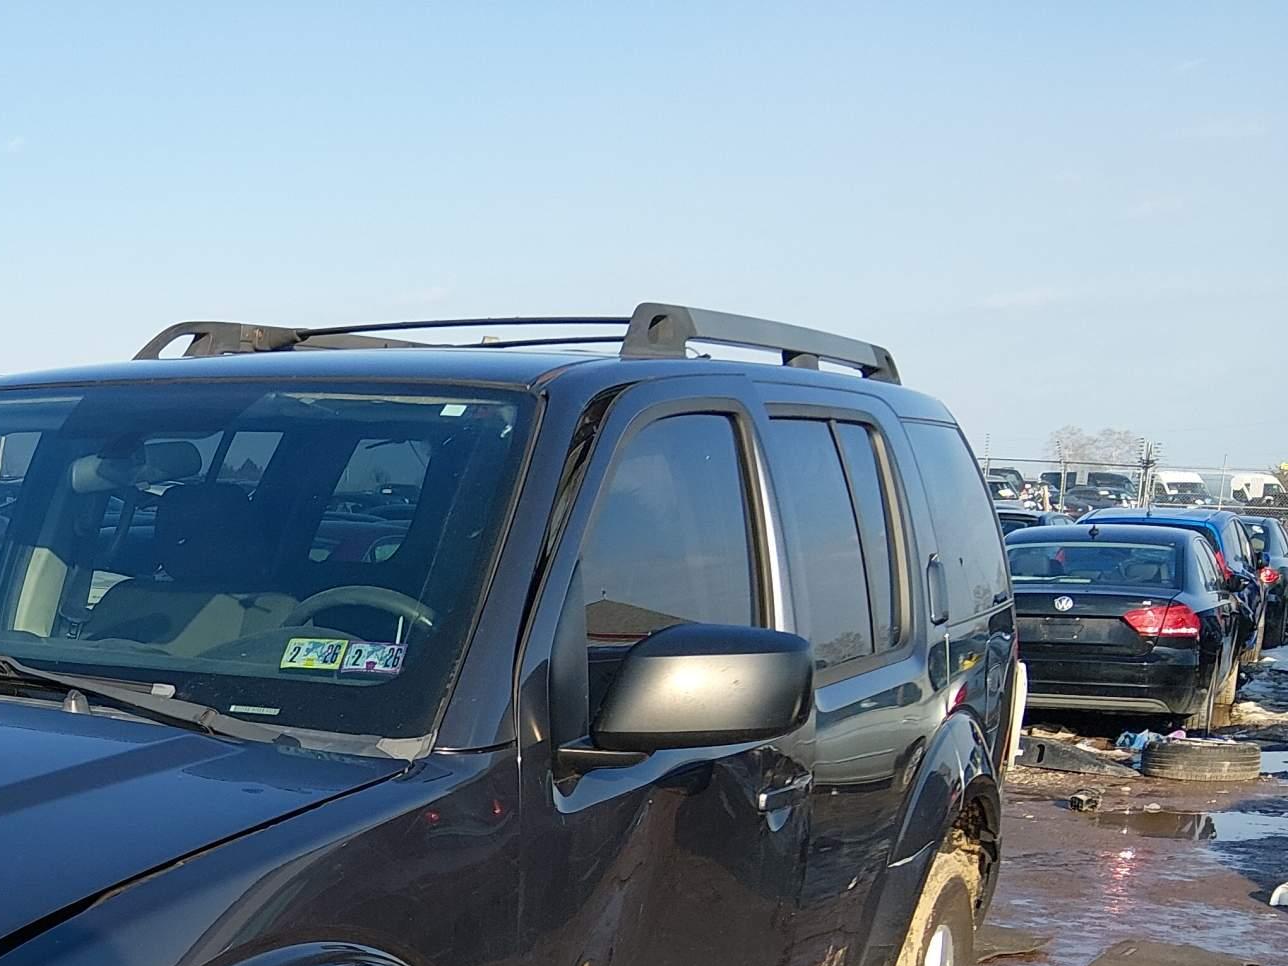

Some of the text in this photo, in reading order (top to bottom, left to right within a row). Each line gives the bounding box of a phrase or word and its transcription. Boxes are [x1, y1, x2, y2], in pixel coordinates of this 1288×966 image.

[288, 643, 342, 664] 2 26
[351, 647, 403, 668] 2 26
